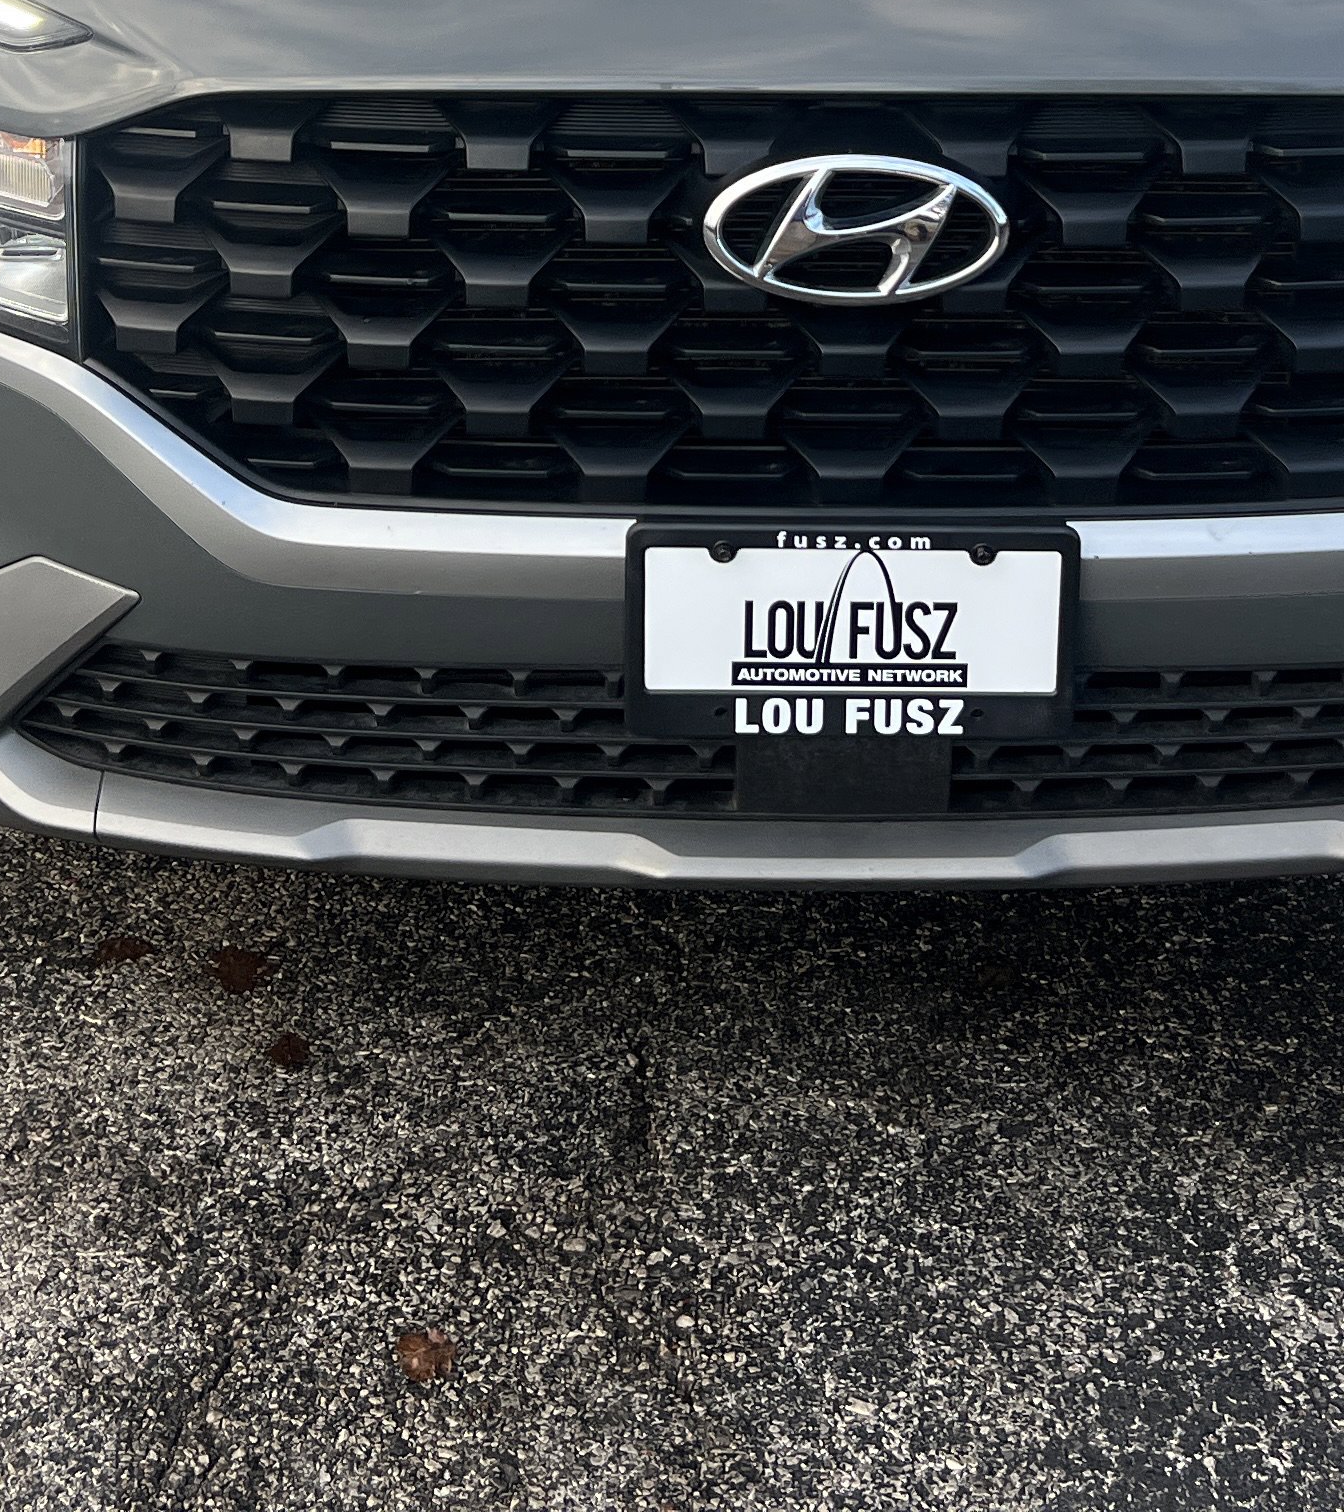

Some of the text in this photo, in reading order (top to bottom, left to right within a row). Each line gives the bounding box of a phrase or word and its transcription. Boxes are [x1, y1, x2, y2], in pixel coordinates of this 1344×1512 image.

[776, 530, 932, 550] fusz.com
[744, 599, 958, 660] LOU FUSZ
[737, 667, 963, 684] AUTOMOTIVE NETWORK
[734, 697, 964, 736] LOU FUSZ
